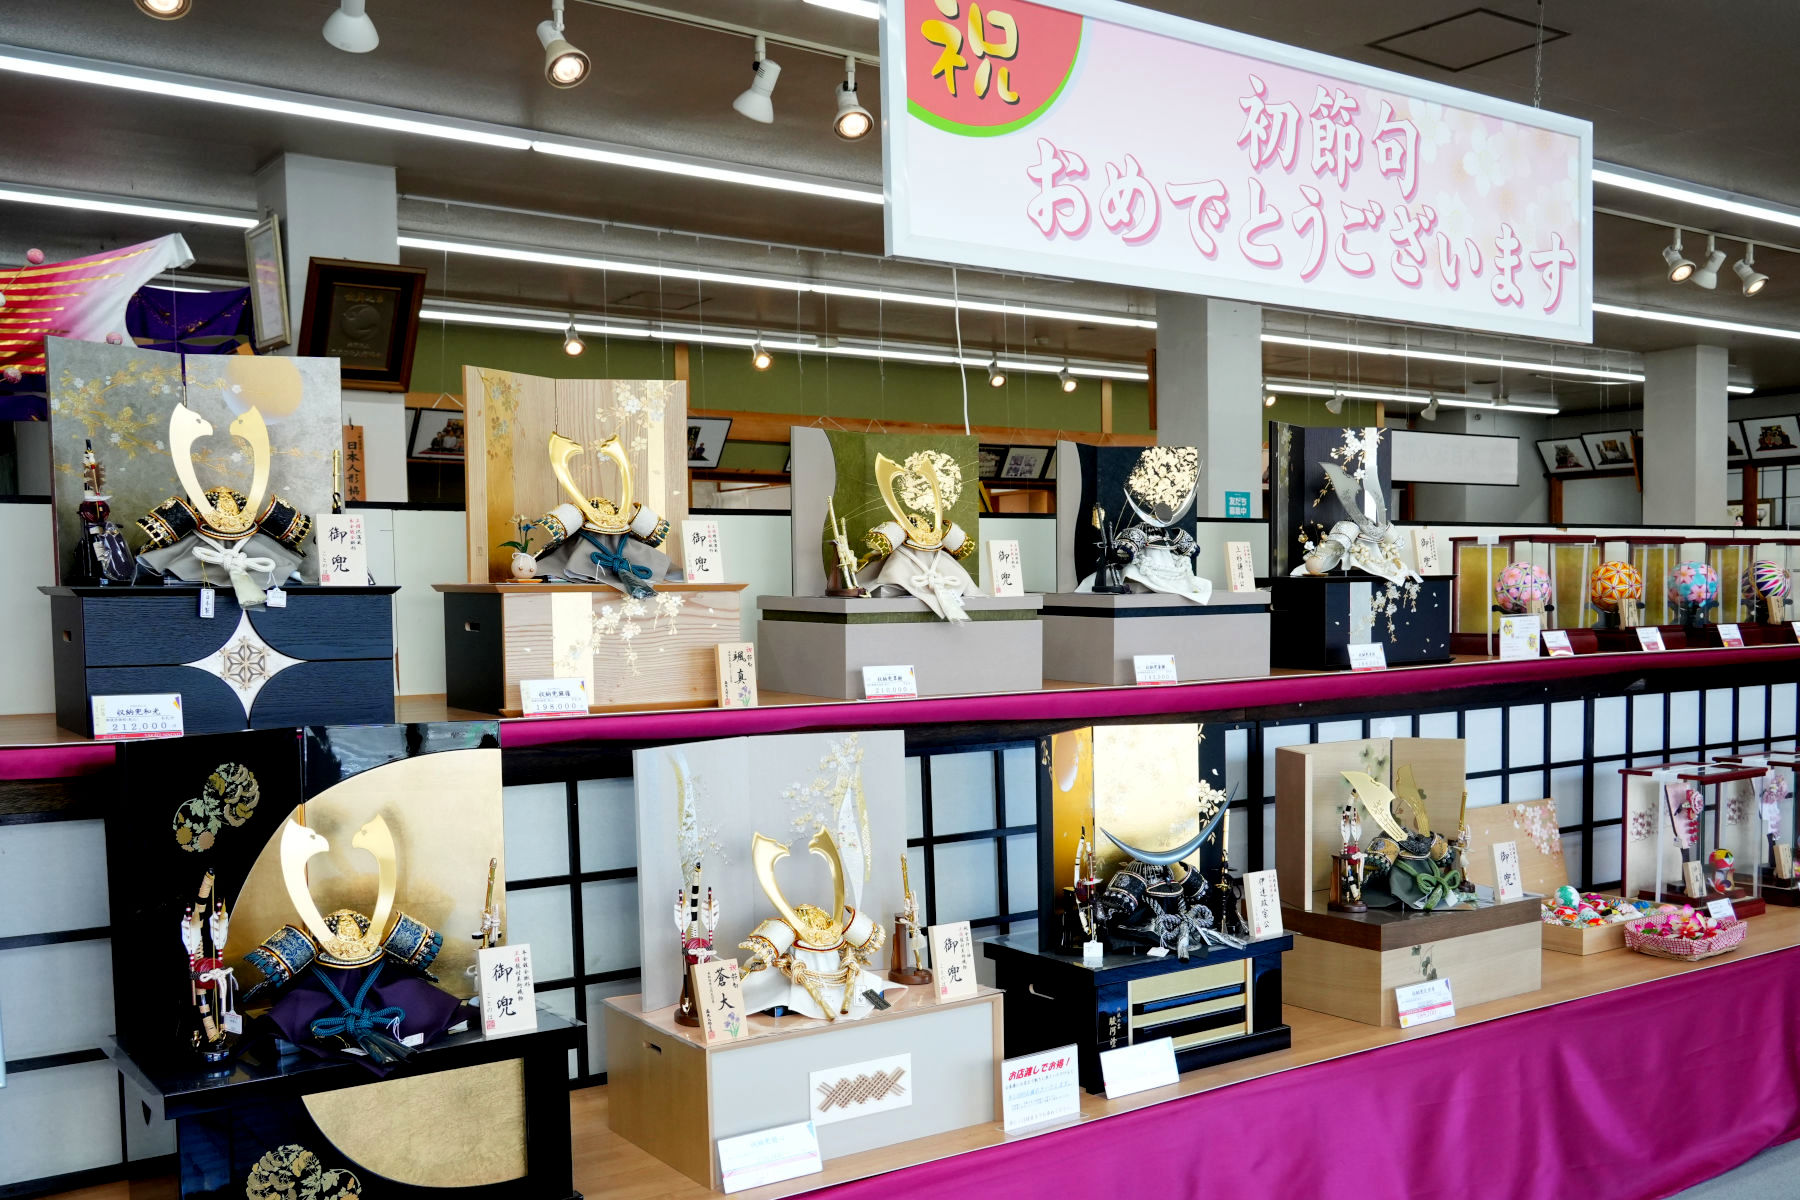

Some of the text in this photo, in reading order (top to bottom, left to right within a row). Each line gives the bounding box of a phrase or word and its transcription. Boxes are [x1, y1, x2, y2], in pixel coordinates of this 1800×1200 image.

[920, 0, 1019, 104] 祝
[1236, 73, 1421, 204] 初節句
[1026, 136, 1577, 314] おめでとうございます
[329, 527, 350, 572] 御兜
[692, 531, 709, 572] 御兜
[998, 550, 1013, 586] 御兜
[944, 938, 963, 983] 御兜
[492, 962, 517, 1018] 御兜
[714, 967, 735, 1011] 蒼大
